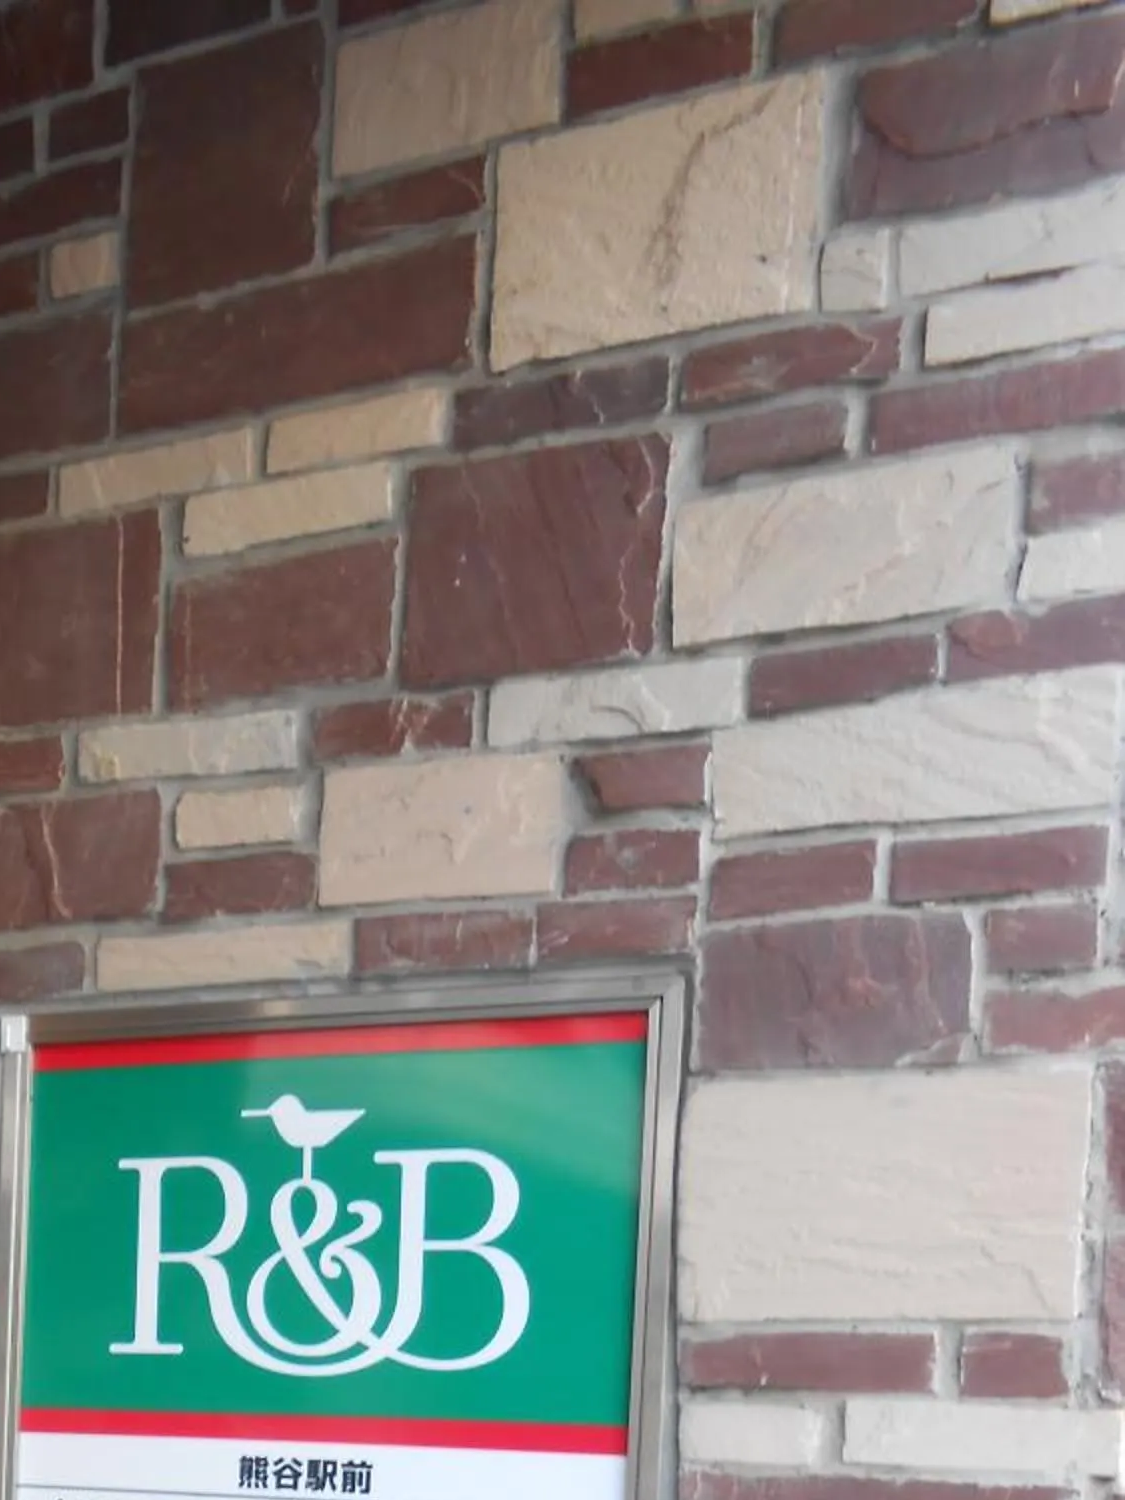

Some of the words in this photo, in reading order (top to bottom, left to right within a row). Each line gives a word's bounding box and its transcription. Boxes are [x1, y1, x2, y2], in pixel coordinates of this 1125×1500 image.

[109, 1149, 530, 1377] R&B
[238, 1455, 374, 1495] 熊谷駅前
